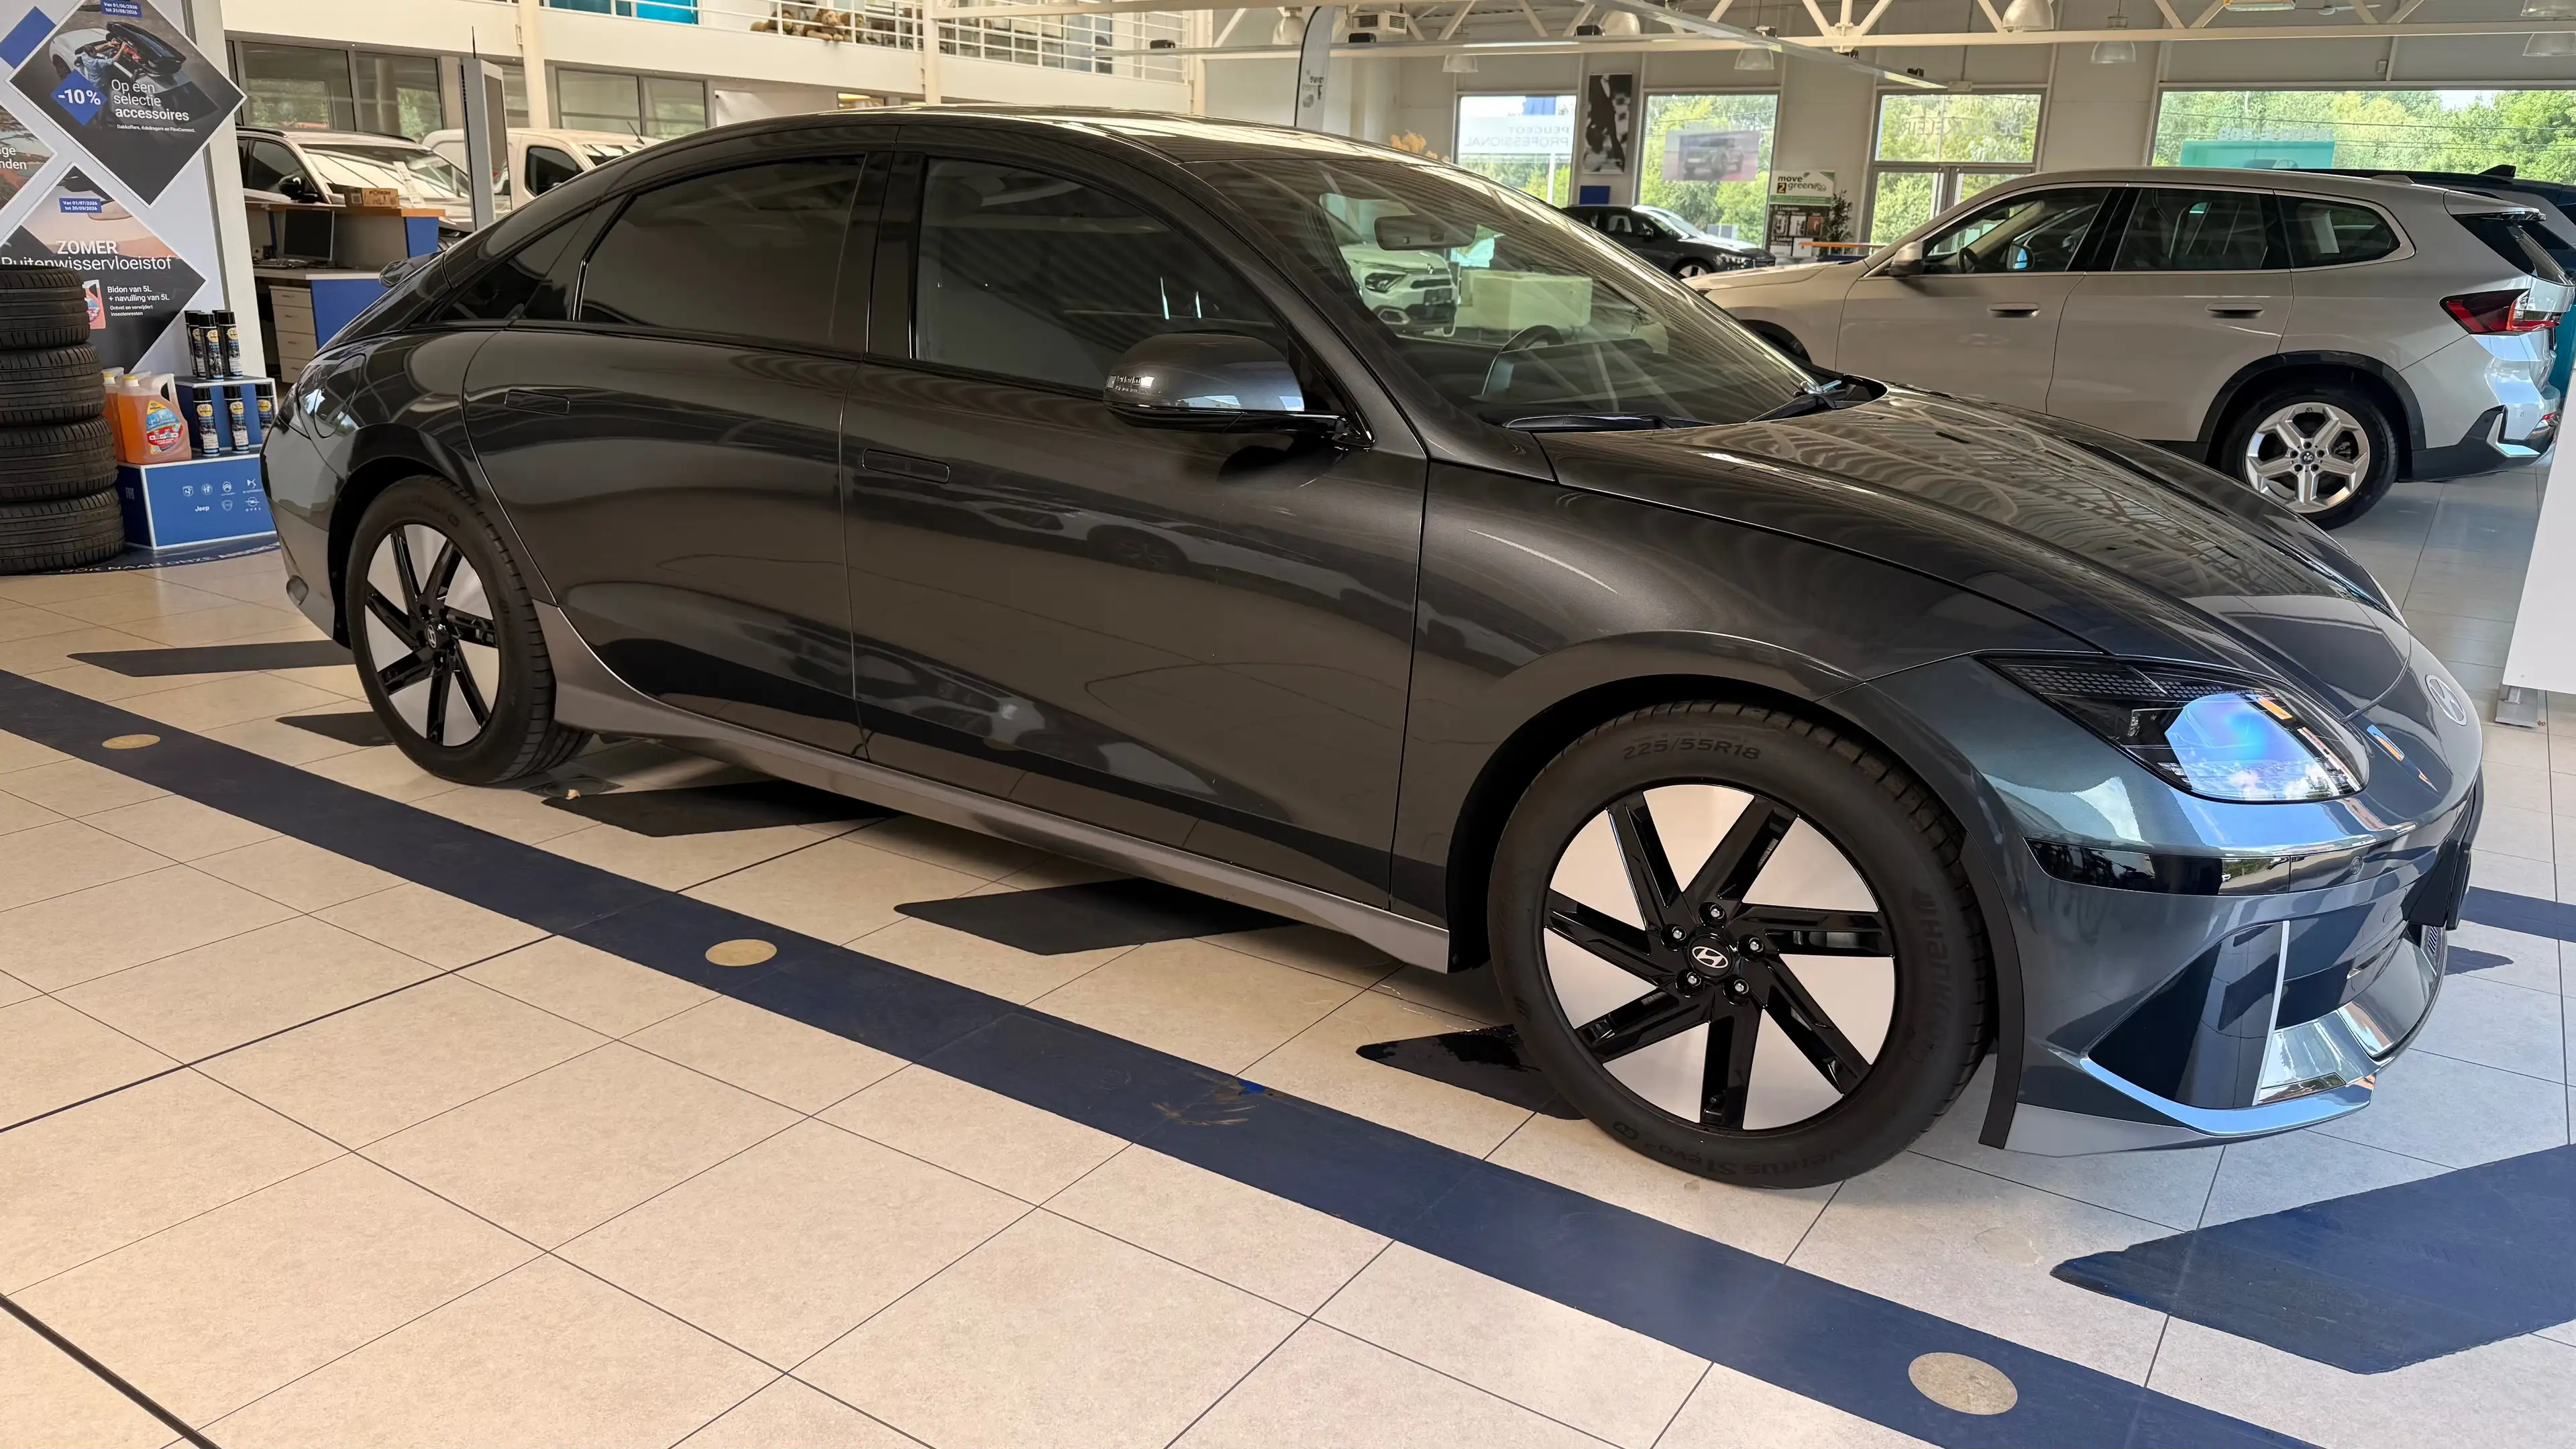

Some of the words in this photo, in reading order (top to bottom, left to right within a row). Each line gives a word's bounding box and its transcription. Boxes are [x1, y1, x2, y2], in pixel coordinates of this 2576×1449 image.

[111, 78, 130, 95] Op
[132, 82, 155, 94] een
[113, 93, 162, 107] selectie
[115, 108, 190, 121] accessoires
[0, 147, 16, 158] ge
[1778, 182, 1786, 193] 2
[57, 240, 119, 255] ZOMER
[107, 286, 128, 294] Bidon
[115, 294, 146, 303] navulling
[1622, 737, 1762, 760] 225/55R18
